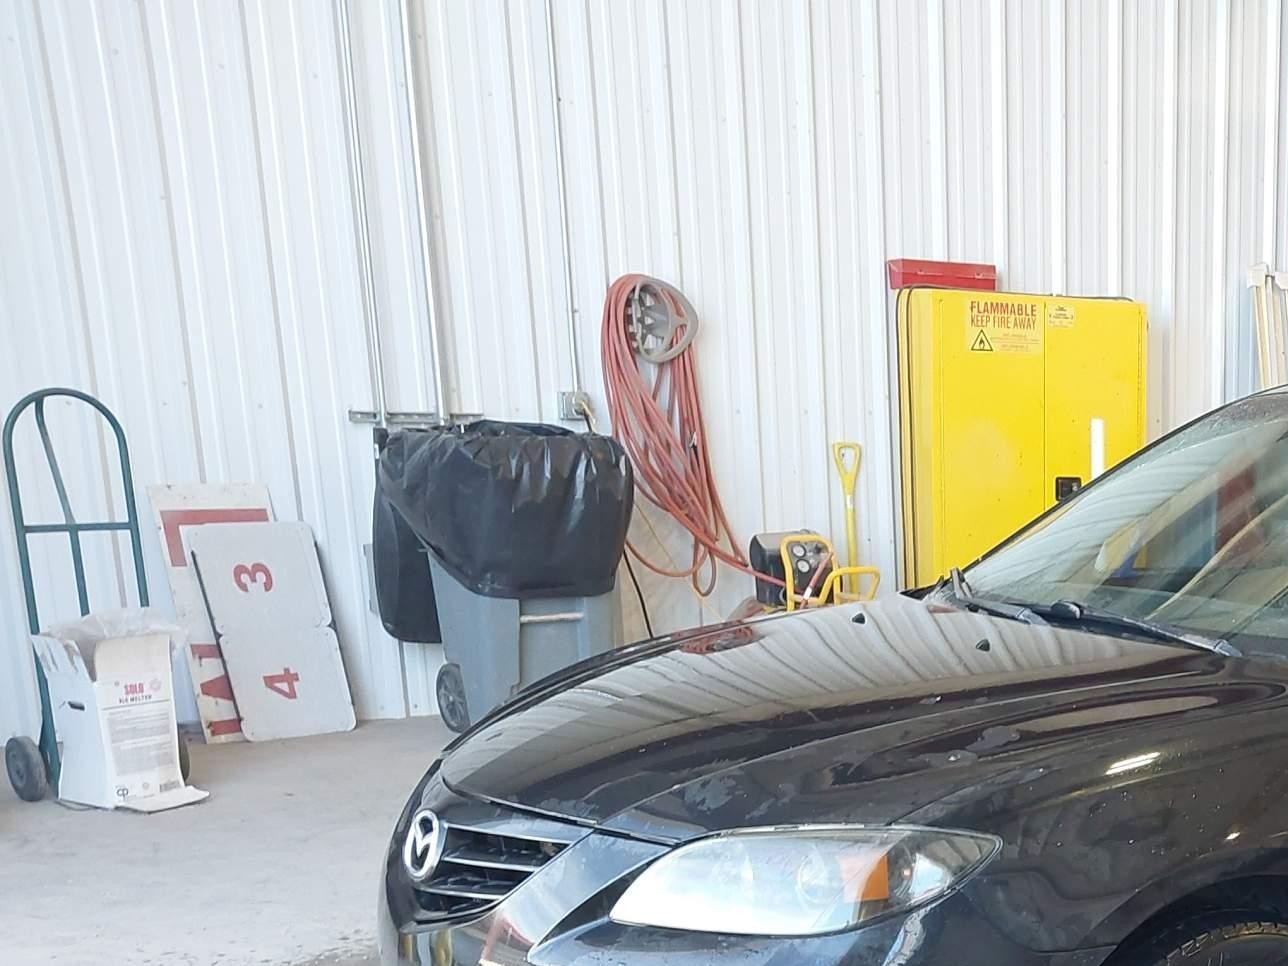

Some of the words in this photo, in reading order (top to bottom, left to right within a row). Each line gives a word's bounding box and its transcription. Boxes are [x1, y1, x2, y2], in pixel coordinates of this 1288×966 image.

[970, 301, 1036, 317] FLAMMABLE
[971, 314, 990, 327] KEEP
[993, 316, 1010, 329] FIRE
[1013, 317, 1036, 330] AWAY
[233, 562, 273, 593] 3
[263, 667, 301, 700] 4
